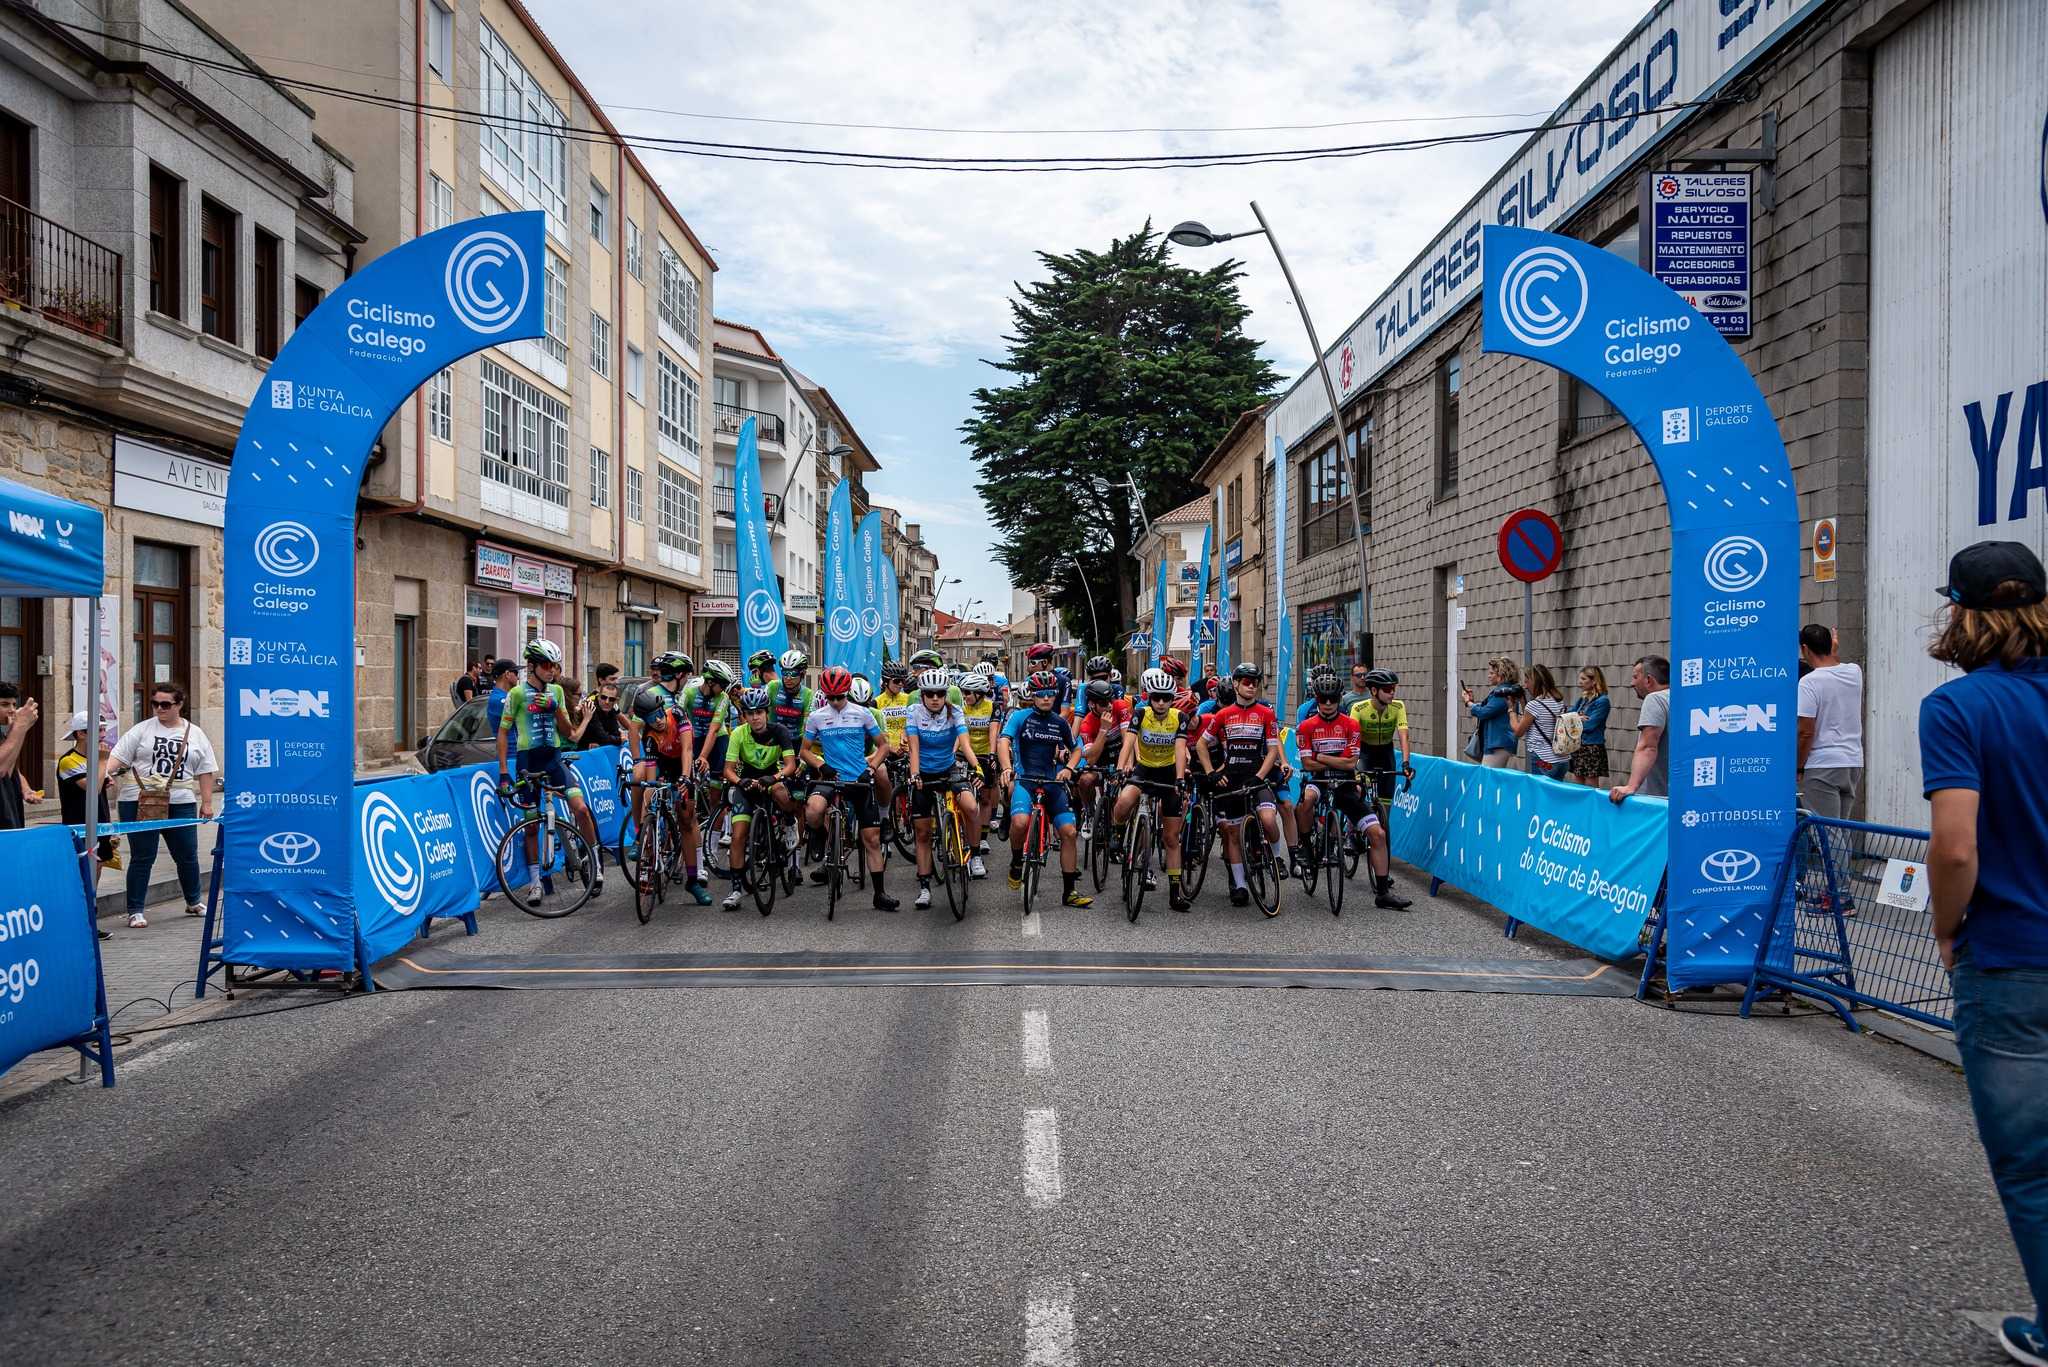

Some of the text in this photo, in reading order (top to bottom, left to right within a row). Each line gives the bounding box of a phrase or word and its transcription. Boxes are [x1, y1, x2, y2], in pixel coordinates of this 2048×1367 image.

[1684, 177, 1746, 186] TALLERES
[1376, 28, 1678, 356] TALLERES SILVOSO
[1684, 188, 1746, 197] SILVOSO
[1667, 215, 1735, 224] NAUTICO
[1671, 231, 1733, 240] REPUESTOS
[1659, 246, 1745, 254] MANTENIMIENTO
[1668, 260, 1735, 269] ACCESORIOS
[1663, 276, 1741, 285] FUERABORDAS
[347, 299, 436, 328] Ciclismo
[1712, 316, 1744, 324] 21 03
[1605, 316, 1690, 339] Ciclismo
[347, 323, 426, 356] Galego
[349, 348, 402, 363] Federación
[1605, 343, 1681, 364] Galego
[1605, 367, 1657, 378] Federación
[298, 384, 345, 401] XUNTA
[297, 398, 373, 419] DE GALICIA
[1705, 404, 1753, 416] DEPORTE
[1705, 415, 1749, 427] GALEGO
[167, 460, 228, 493] AVENI
[479, 547, 510, 566] SEGUROS
[864, 529, 873, 603] Ciclismo Galego
[253, 582, 317, 597] Ciclismo
[253, 596, 309, 613] Galego
[1704, 600, 1766, 613] Ciclismo
[1704, 614, 1759, 627] Galego
[257, 640, 307, 653] XUNTA
[256, 653, 339, 666] DE GALICIA
[1708, 656, 1757, 669] XUNTA
[1707, 667, 1788, 682] DE GALICIA
[284, 742, 326, 750] DEPORTE
[284, 750, 322, 758] GALEGO
[1730, 757, 1772, 766] DEPORTE
[1729, 766, 1767, 774] GALEGO
[588, 775, 612, 792] Ciclismo
[257, 793, 338, 806] OTTOBOSLEY
[593, 797, 615, 815] Galego
[413, 808, 453, 835] Ciclismo
[1701, 809, 1782, 823] OTTOBOSLEY
[1528, 815, 1592, 857] O Ciclismo
[424, 840, 457, 865] Galego
[1519, 846, 1648, 914] do fogar de Breogán
[1692, 885, 1741, 895] COMPOSTELA
